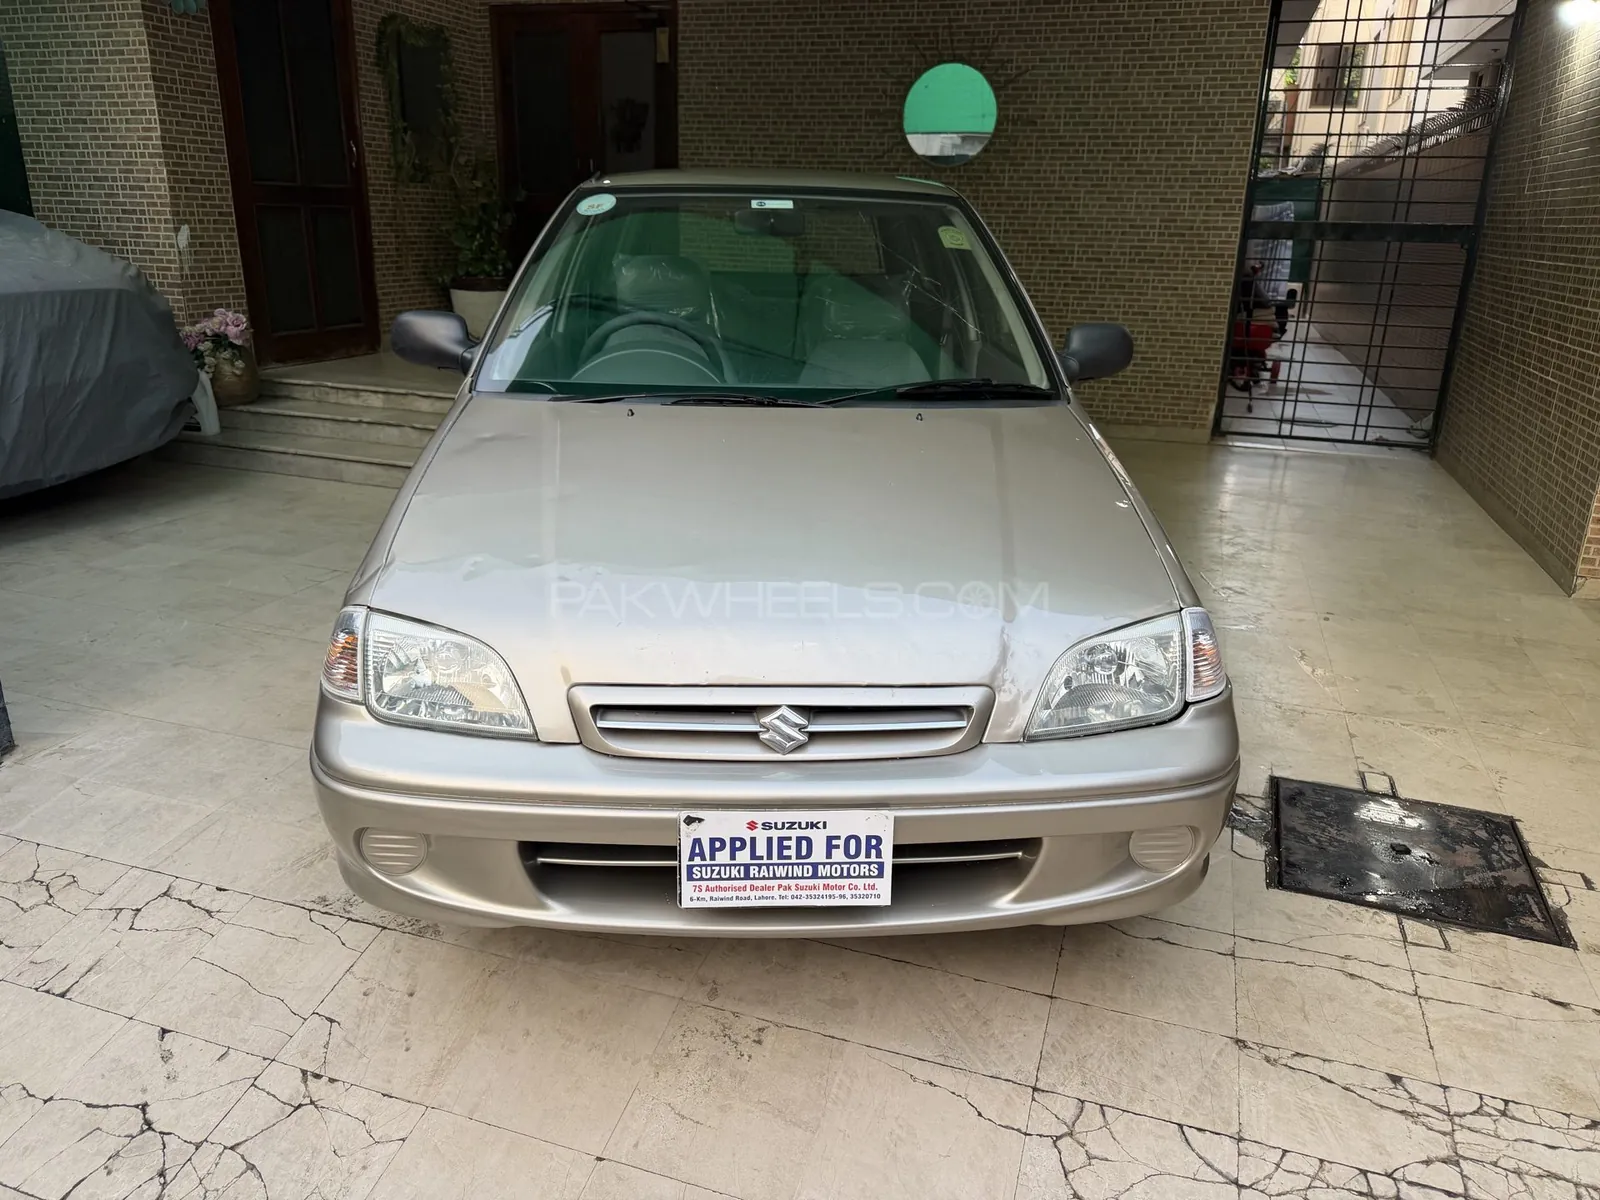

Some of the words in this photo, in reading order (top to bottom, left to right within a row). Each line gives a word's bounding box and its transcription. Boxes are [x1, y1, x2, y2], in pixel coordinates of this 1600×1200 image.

[761, 821, 827, 831] SUZUKI
[688, 836, 813, 862] APPLIED
[825, 834, 883, 860] FOR
[692, 866, 745, 879] SUZUKI
[749, 865, 813, 878] RAIWIND
[818, 864, 879, 877] MOTORS
[692, 884, 703, 893] 7S
[705, 884, 747, 892] Authorised
[749, 884, 775, 892] Dealer
[777, 883, 792, 891] Pak
[794, 883, 820, 891] Suzuki
[822, 883, 845, 891] Motor
[848, 883, 861, 891] Co.
[863, 883, 878, 891] Ltd.
